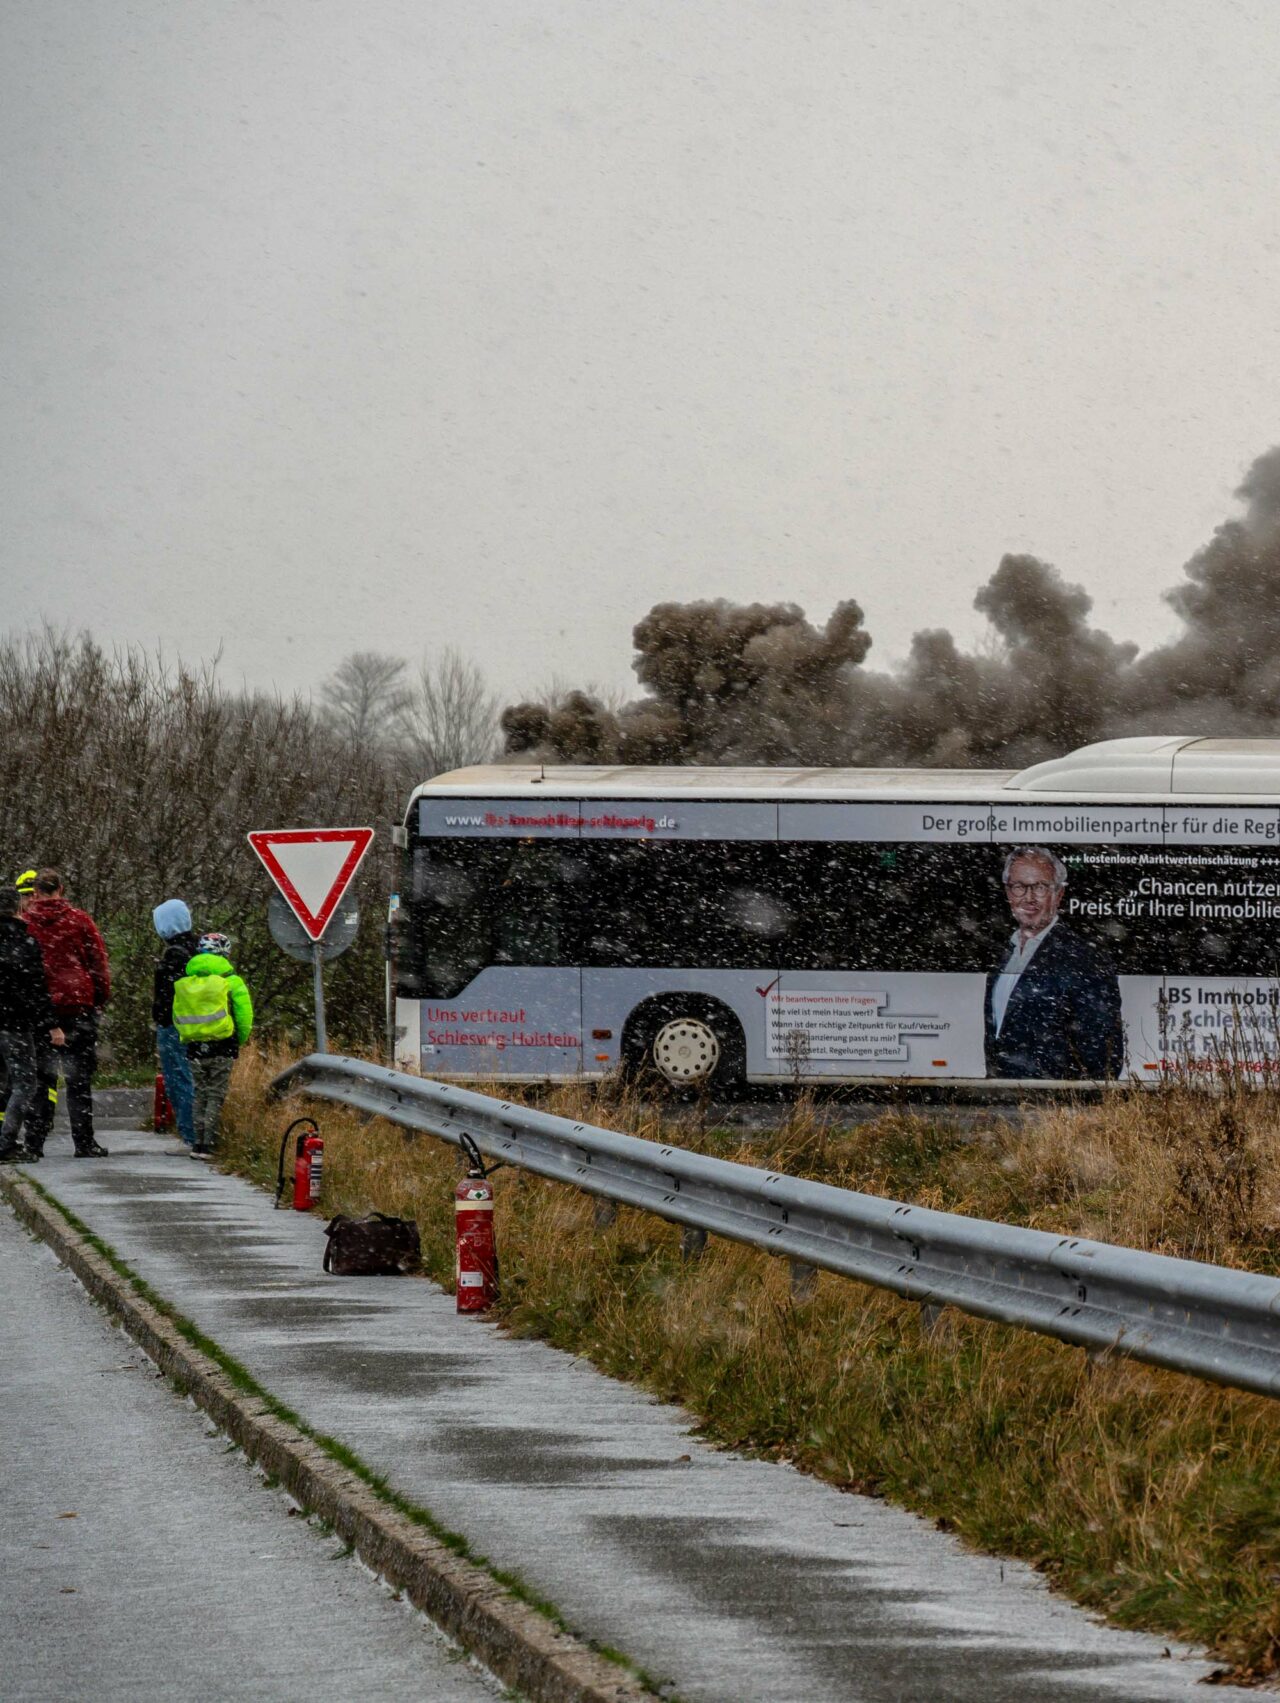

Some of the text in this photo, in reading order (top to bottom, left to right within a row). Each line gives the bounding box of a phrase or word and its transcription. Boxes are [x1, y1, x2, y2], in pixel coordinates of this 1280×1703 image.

[922, 815, 953, 831] Der
[956, 815, 1008, 837] große
[1012, 816, 1178, 837] Immobilienpartner
[1182, 816, 1208, 834] für
[1212, 817, 1239, 834] die
[1083, 853, 1137, 865] kostenlose
[1138, 854, 1258, 868] Marktwerteinschätzung
[1129, 877, 1218, 898] „Chancen
[1069, 899, 1112, 915] Preis
[1117, 898, 1145, 917] für
[1149, 899, 1185, 917] Ihre
[771, 995, 784, 1004] Wir
[785, 994, 833, 1004] beantworten
[834, 995, 850, 1004] Ihre
[1158, 987, 1192, 1004] LBS
[427, 1007, 526, 1024] Uns vertraut
[771, 1008, 874, 1017] Wie viel ist mein Haus wert?
[771, 1020, 951, 1031] Wann ist der richtige Zeitpunkt für Kauf/Verkauf?
[848, 1034, 868, 1044] passt
[829, 1047, 873, 1057] Regelungen
[873, 1047, 901, 1057] gelten?
